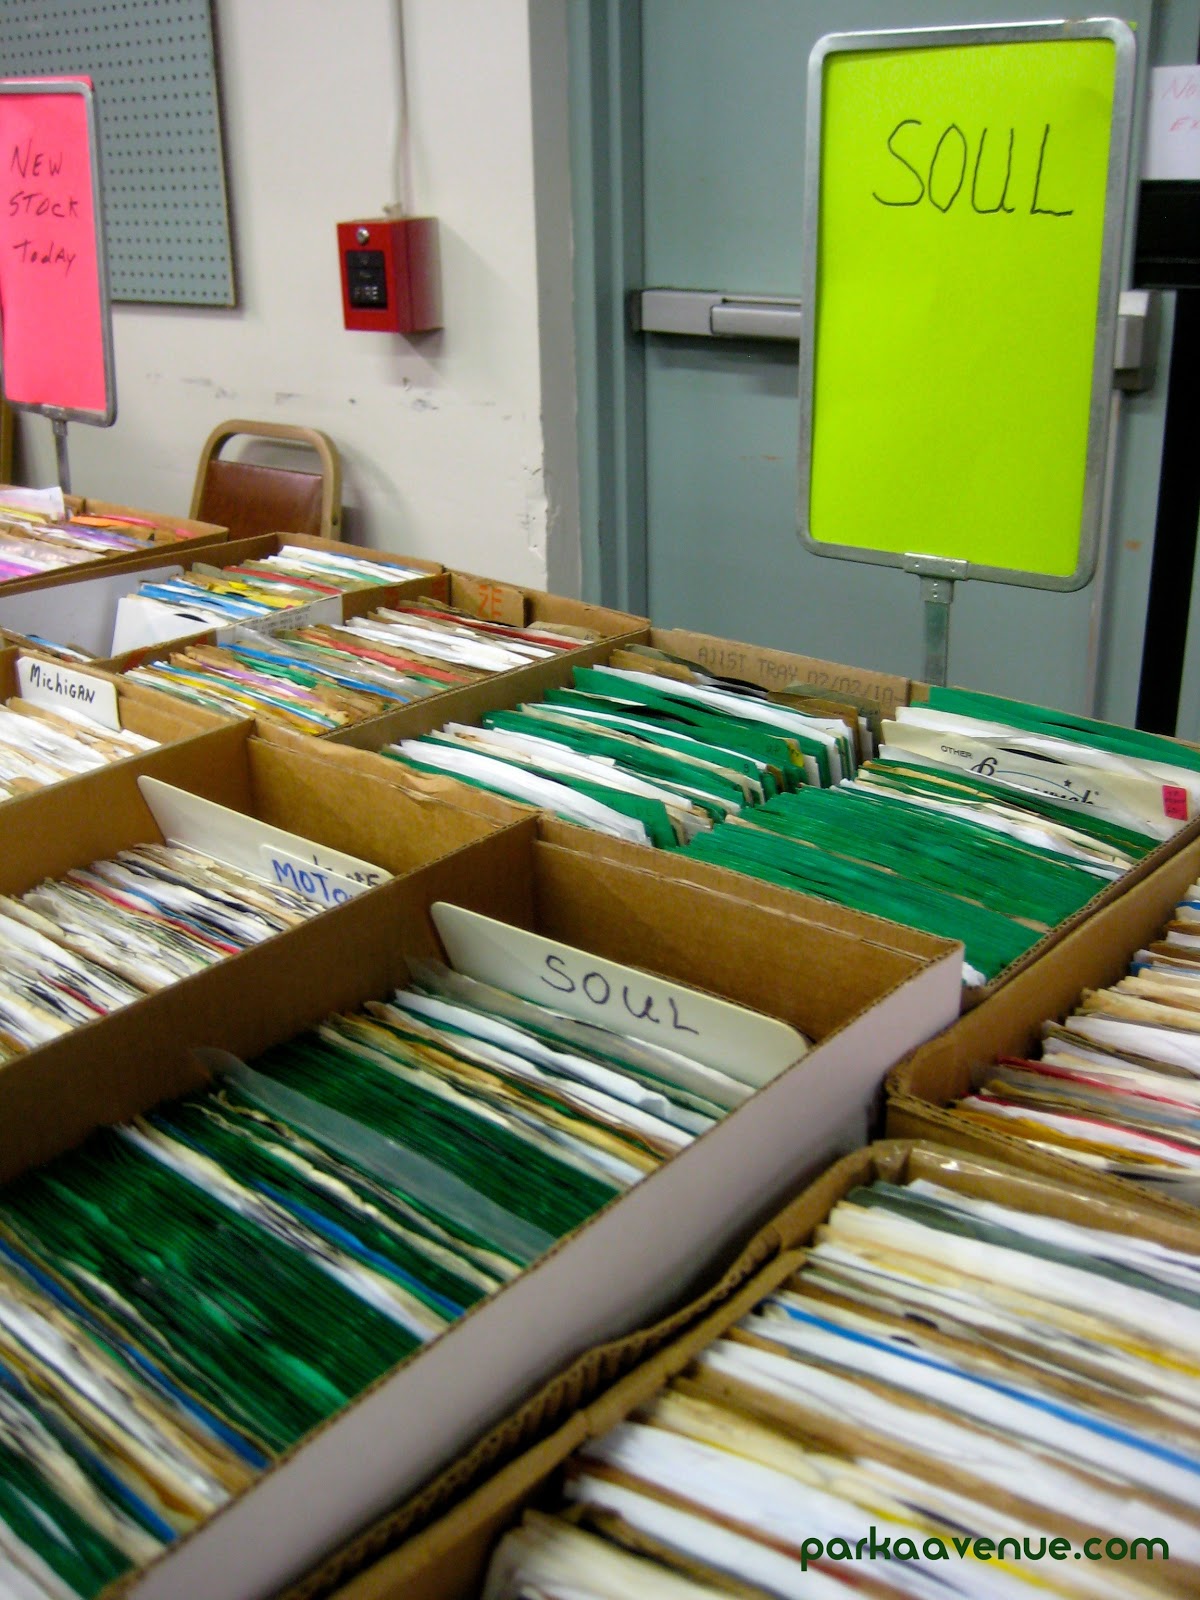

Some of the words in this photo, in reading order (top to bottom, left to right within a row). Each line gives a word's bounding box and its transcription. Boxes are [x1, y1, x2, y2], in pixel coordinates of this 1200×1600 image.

[10, 138, 63, 178] NEW
[872, 119, 1074, 216] SOUL
[758, 658, 798, 682] TRAY
[940, 745, 973, 760] OTHER
[271, 859, 354, 903] MOTO
[540, 954, 700, 1036] SOUL
